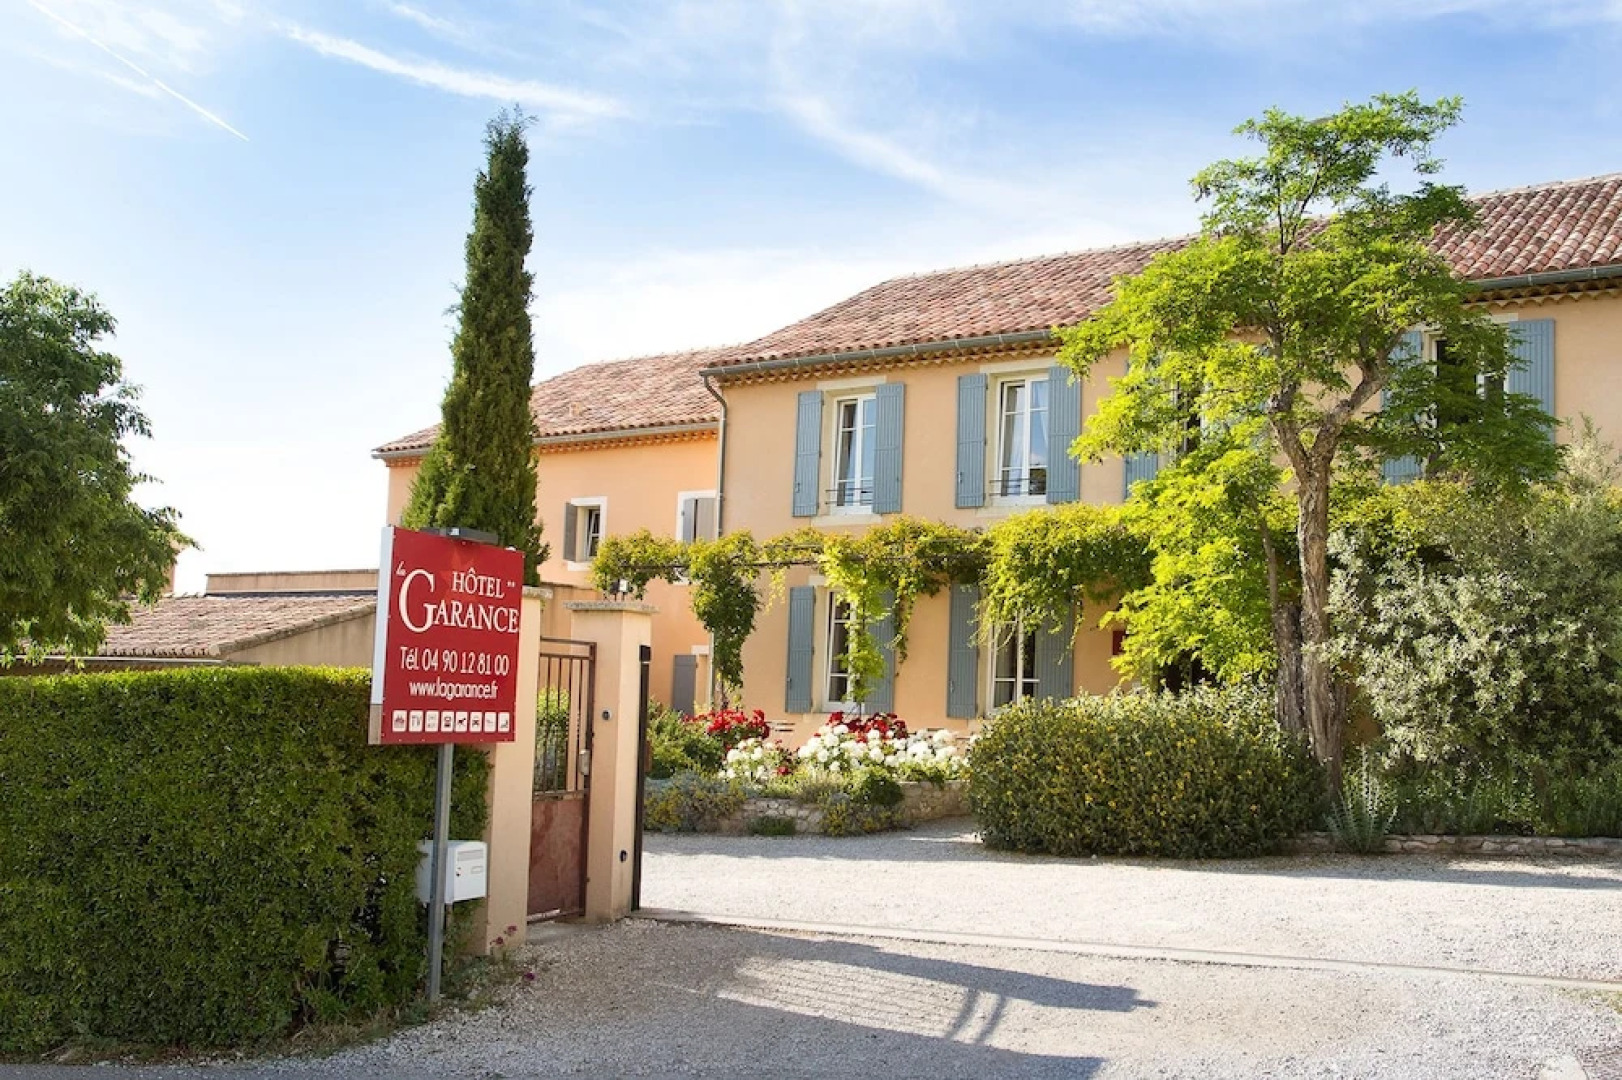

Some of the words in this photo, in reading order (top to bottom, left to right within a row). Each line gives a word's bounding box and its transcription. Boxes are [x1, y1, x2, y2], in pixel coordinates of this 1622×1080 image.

[452, 567, 504, 598] HÔTEL
[399, 569, 519, 633] GARANCE
[422, 648, 438, 671] 04
[442, 650, 458, 673] 90
[460, 652, 474, 674] 12
[477, 652, 491, 675] 81
[494, 654, 509, 676] 00
[409, 676, 498, 700] www.lagarance.fr
